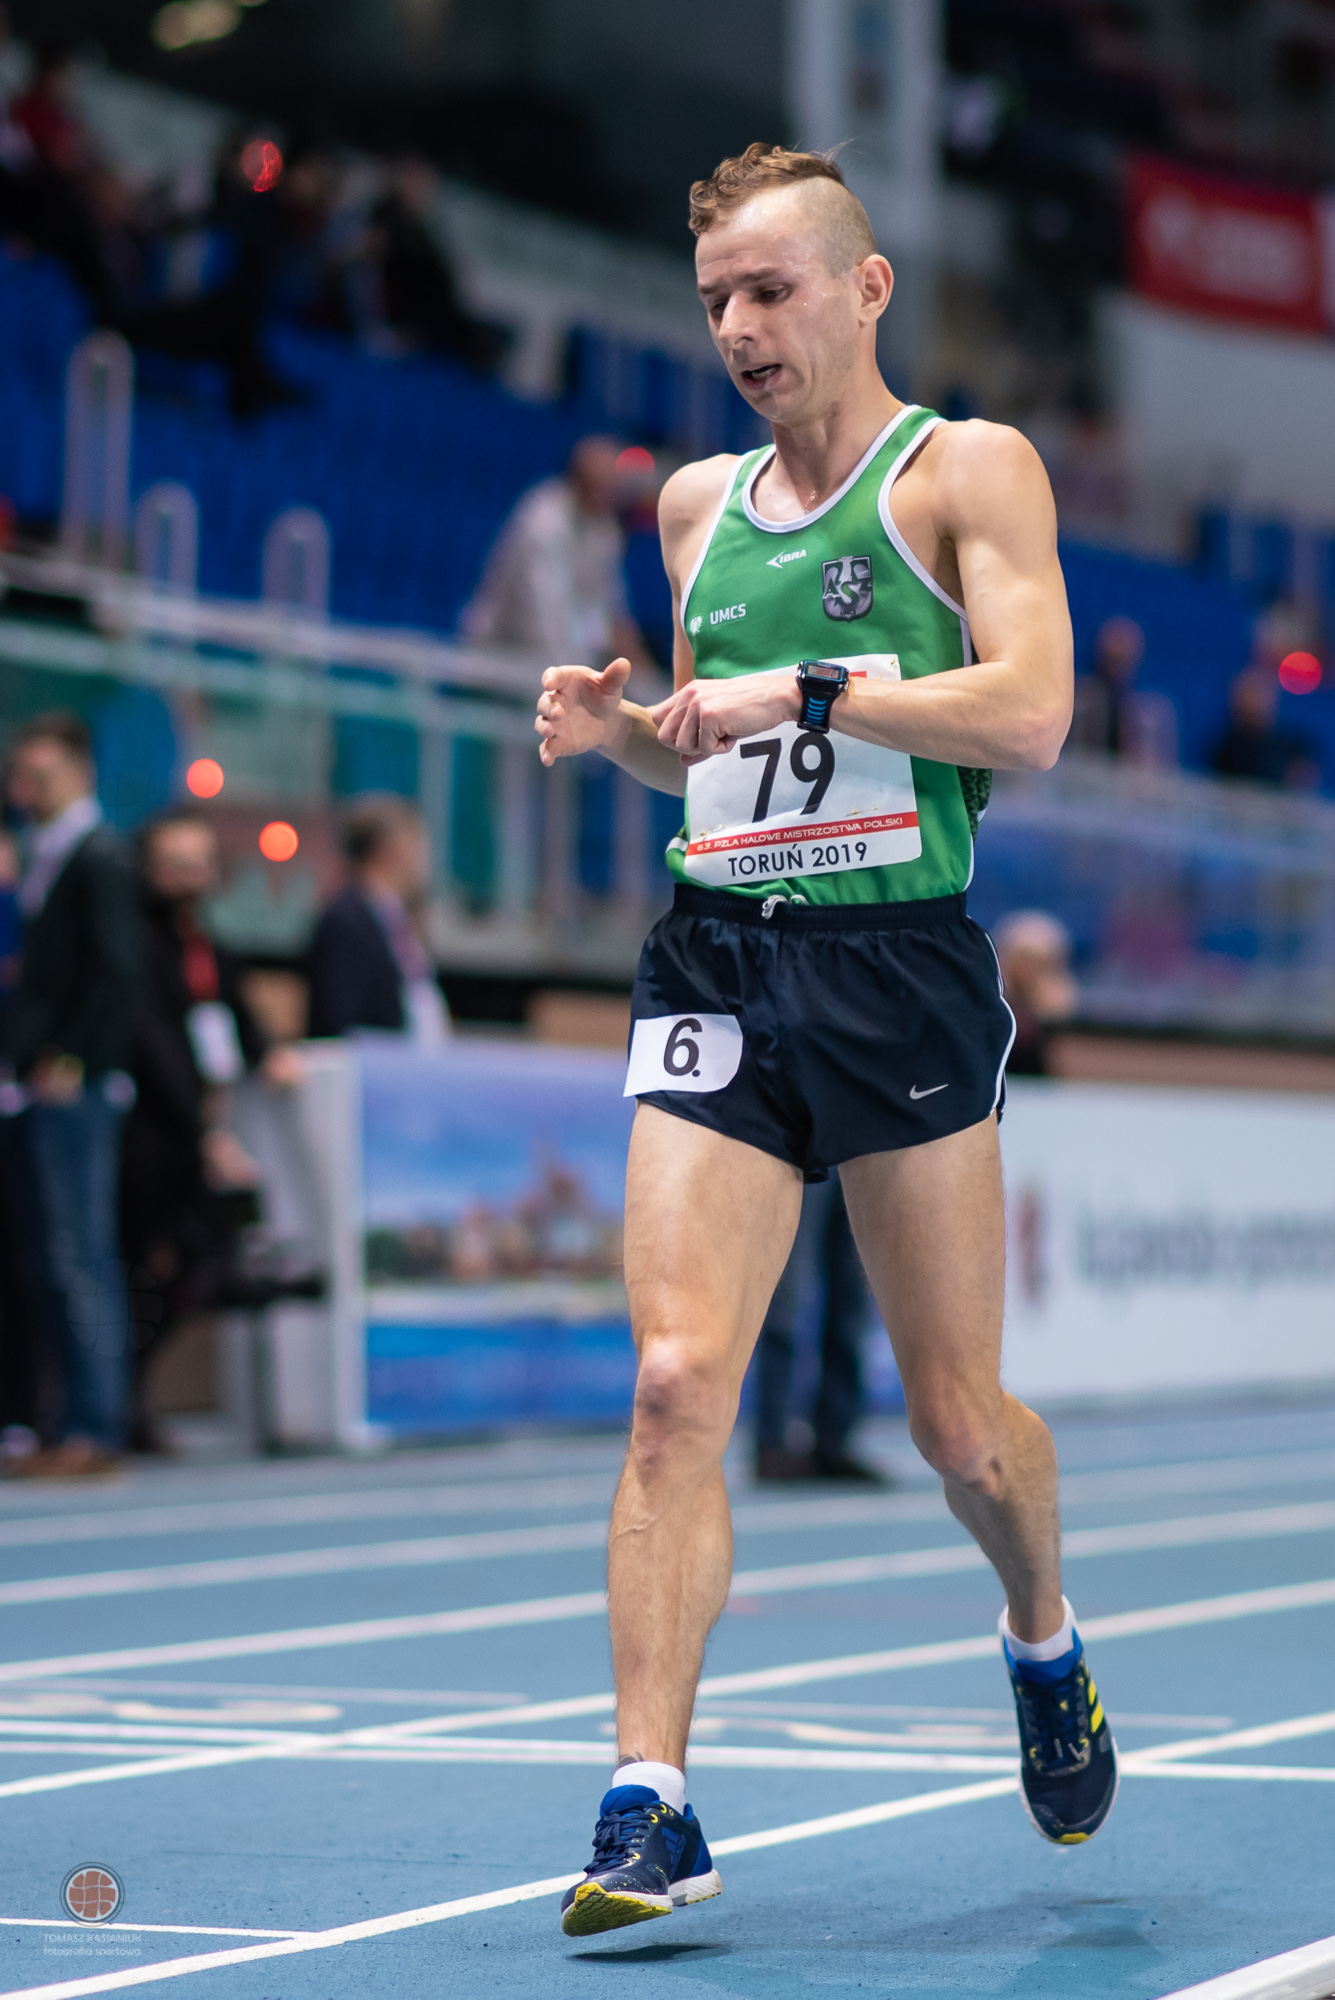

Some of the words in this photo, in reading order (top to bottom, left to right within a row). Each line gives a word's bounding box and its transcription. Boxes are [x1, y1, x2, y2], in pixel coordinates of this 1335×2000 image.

[709, 603, 747, 625] UMCS
[740, 731, 835, 823] 79
[714, 839, 739, 848] PZLA
[740, 833, 782, 845] HALOWE
[783, 823, 862, 840] MISTRZOSTWA
[863, 817, 903, 829] POLSKI
[728, 843, 804, 877] TORUŃ
[811, 841, 867, 867] 2019
[663, 1017, 703, 1077] 6.
